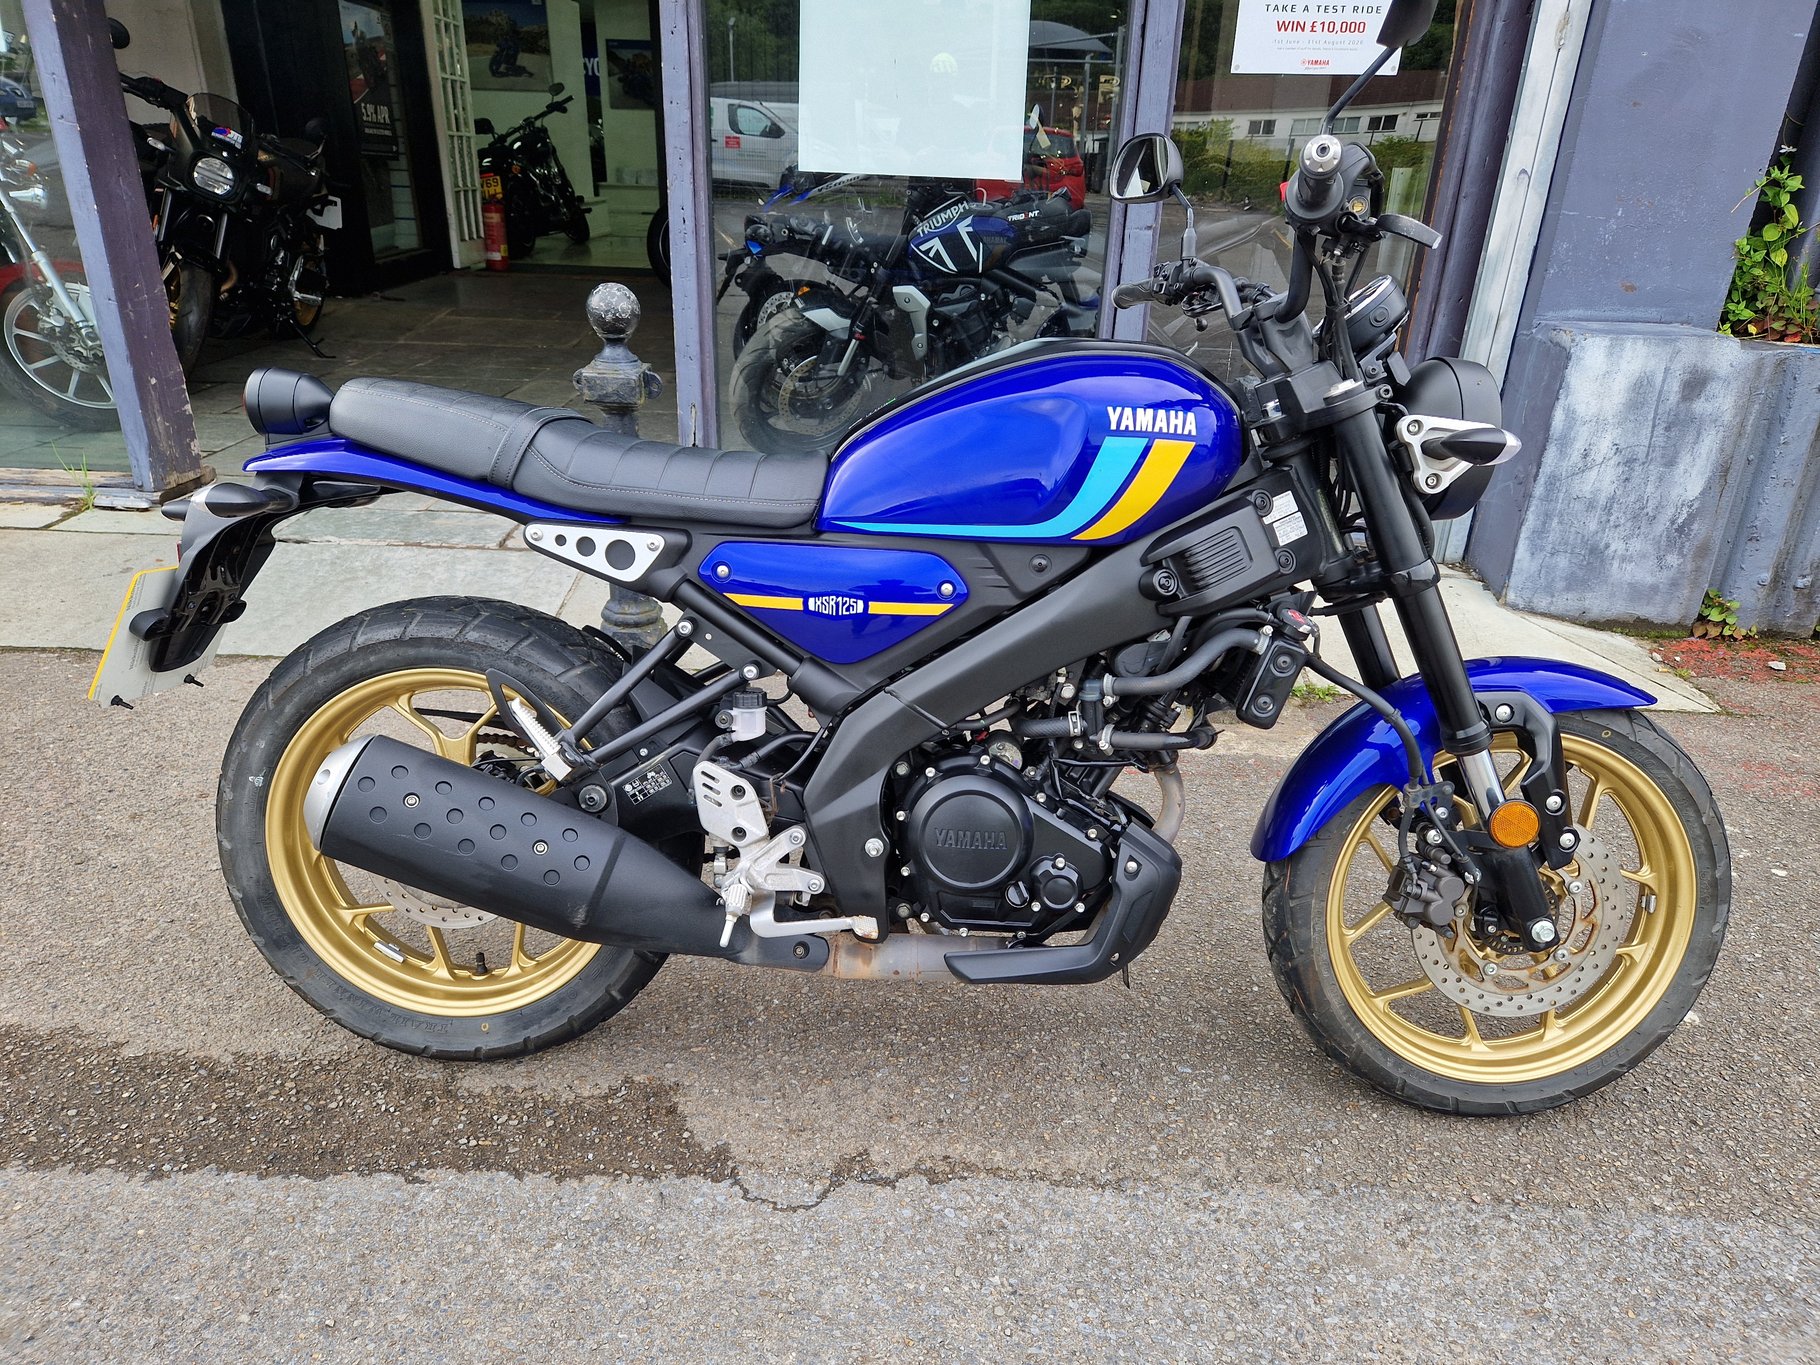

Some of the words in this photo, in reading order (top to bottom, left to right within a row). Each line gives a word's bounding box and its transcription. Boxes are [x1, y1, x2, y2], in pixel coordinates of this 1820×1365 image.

[1265, 4, 1297, 13] TAKE
[1302, 4, 1310, 13] A
[1316, 5, 1347, 14] TEST
[1352, 5, 1382, 15] RIDE
[1276, 20, 1306, 33] WIN
[1309, 20, 1367, 35] £10,000
[916, 200, 970, 237] TRIUMPH
[1106, 405, 1197, 436] YAMAHA
[815, 595, 857, 616] XSR125
[934, 827, 1008, 850] YAMAHA
